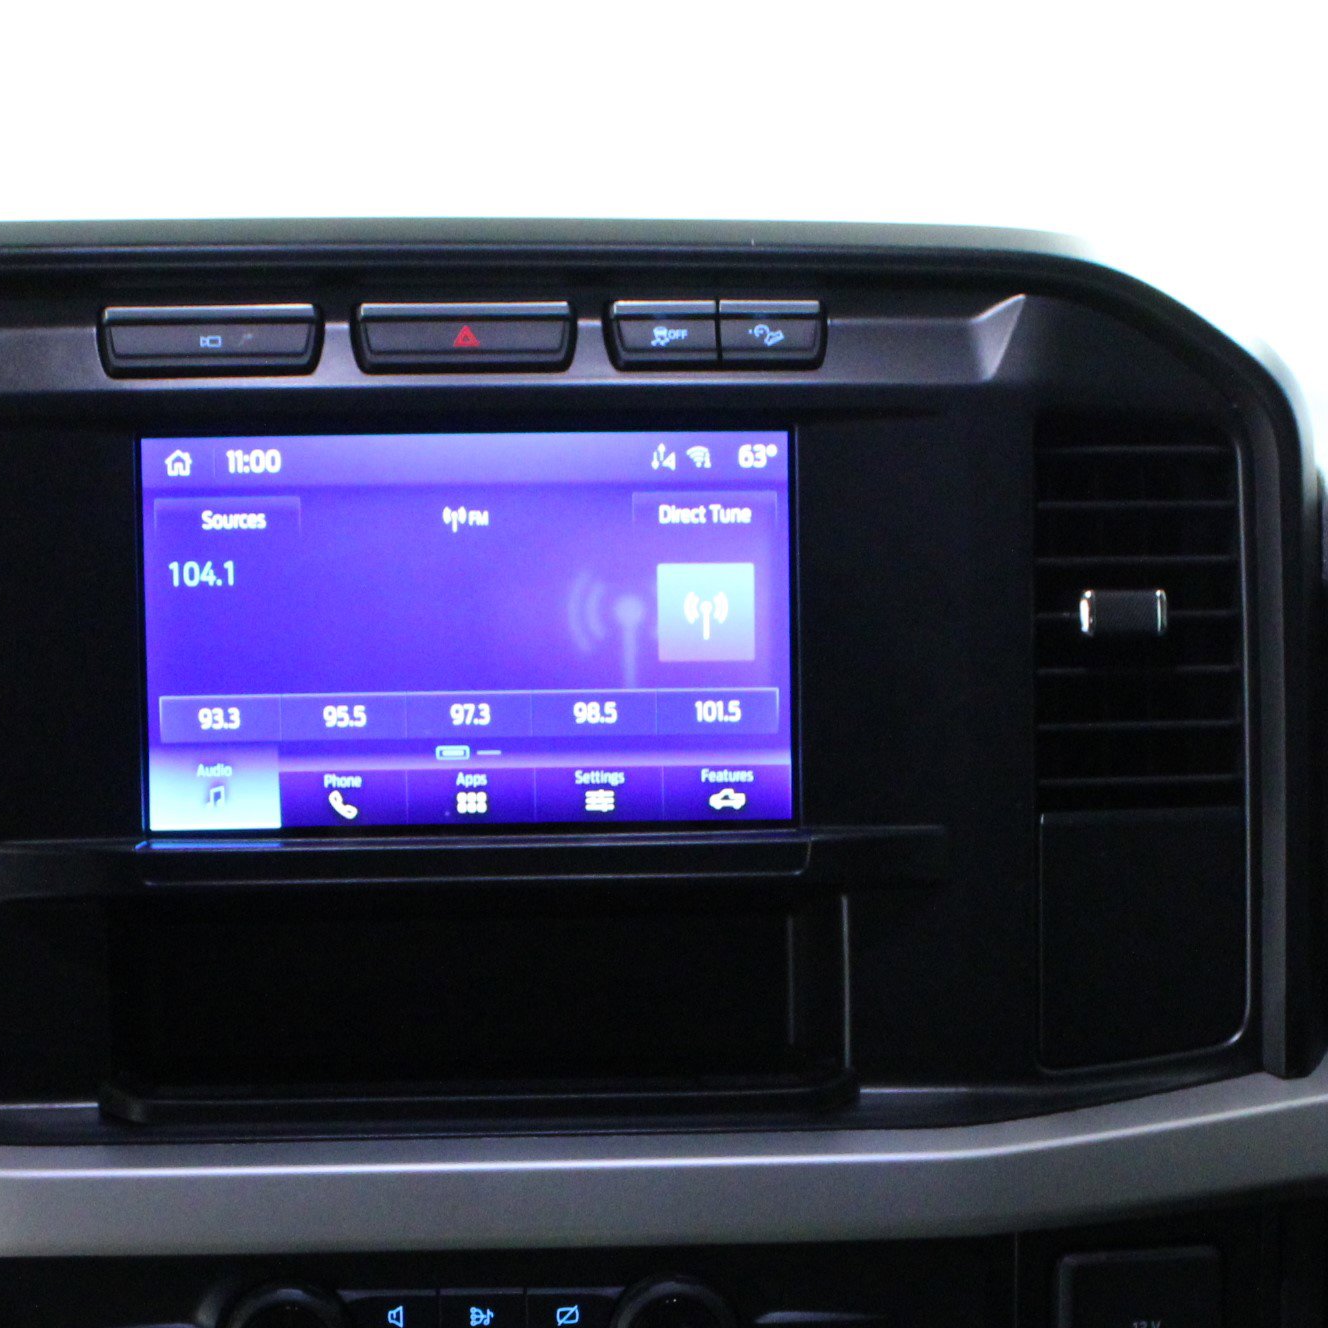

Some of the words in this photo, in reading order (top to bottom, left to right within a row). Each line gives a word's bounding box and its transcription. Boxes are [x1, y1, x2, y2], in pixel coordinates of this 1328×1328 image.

[668, 328, 688, 340] OFF
[226, 449, 281, 473] 11:00
[738, 444, 777, 468] 63°
[201, 510, 266, 530] Sources
[468, 510, 489, 526] FM
[658, 504, 706, 524] Direct
[709, 504, 752, 524] Tune
[168, 561, 235, 587] 104.1
[198, 707, 241, 730] 93.3
[323, 705, 366, 728] 95.5
[450, 703, 490, 725] 97.3
[574, 701, 617, 724] 98.5
[695, 700, 741, 722] 101.5
[197, 763, 232, 778] Audio
[456, 772, 487, 787] Apps
[574, 769, 625, 787] Settings
[701, 768, 753, 784] Features
[324, 773, 362, 789] Phone
